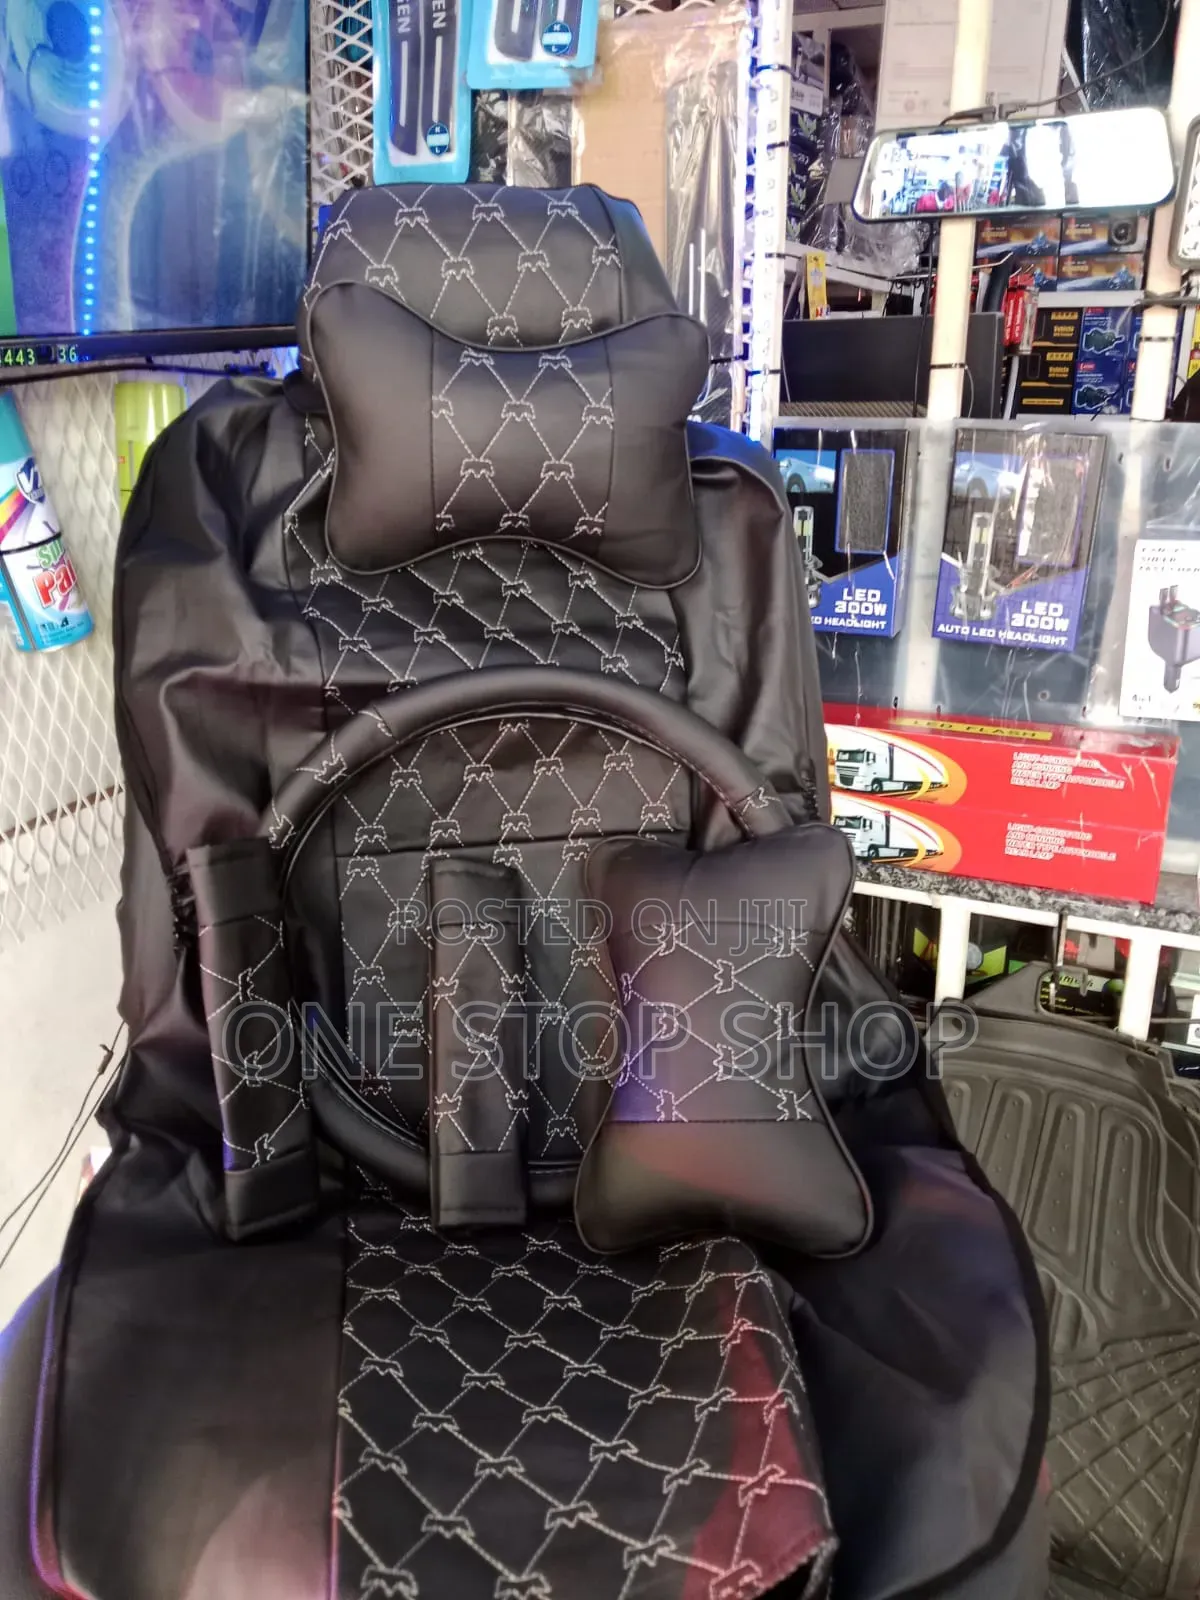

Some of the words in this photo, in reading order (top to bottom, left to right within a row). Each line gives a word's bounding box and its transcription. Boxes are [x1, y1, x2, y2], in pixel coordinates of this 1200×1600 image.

[0, 348, 35, 366] 443
[843, 588, 881, 602] LED
[834, 600, 887, 616] 300W
[1021, 600, 1064, 617] LED
[824, 616, 887, 629] HEADLIGHT
[1010, 613, 1069, 632] 300W
[937, 623, 970, 635] AUTO
[972, 627, 995, 638] LED
[998, 630, 1068, 646] HEADLIGHT
